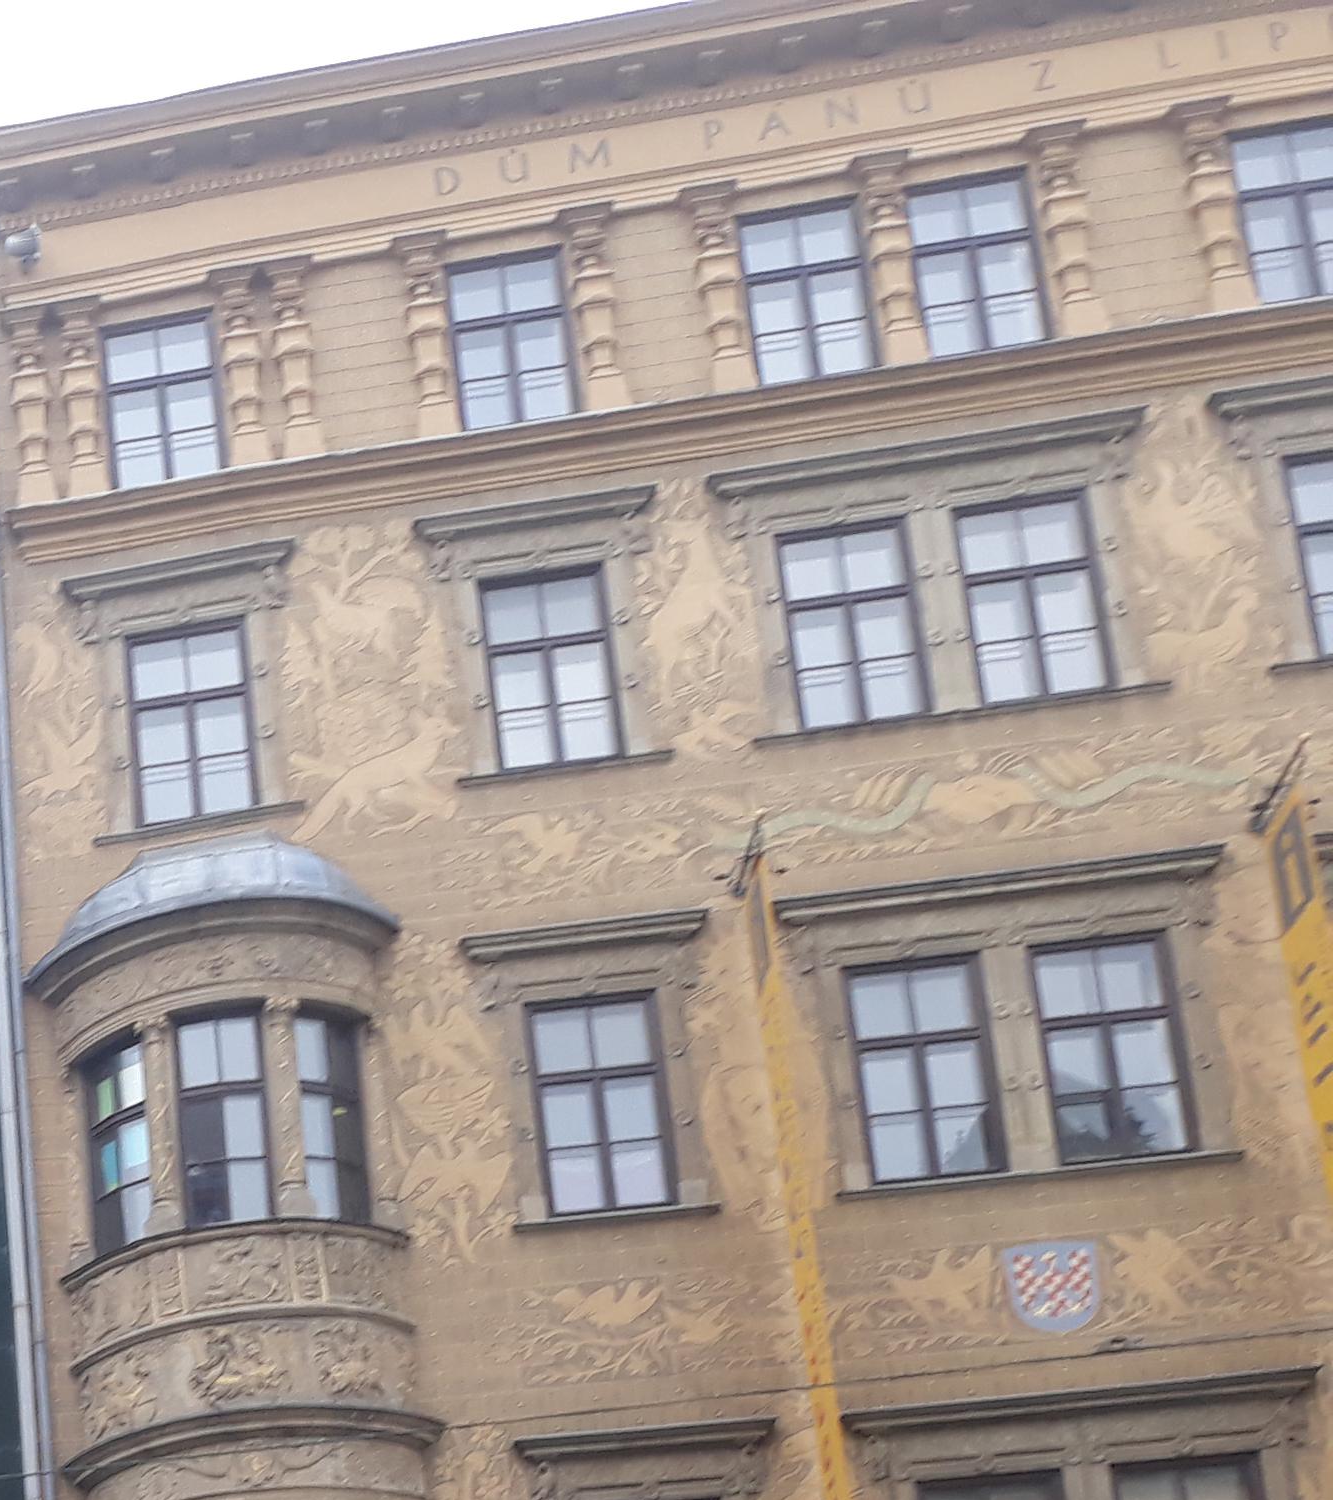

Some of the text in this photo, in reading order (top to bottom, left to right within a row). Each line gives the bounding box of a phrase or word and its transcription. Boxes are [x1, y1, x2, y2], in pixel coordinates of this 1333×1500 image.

[435, 139, 612, 197] DŮM
[1029, 59, 1057, 93] Z
[1157, 14, 1333, 70] LIP
